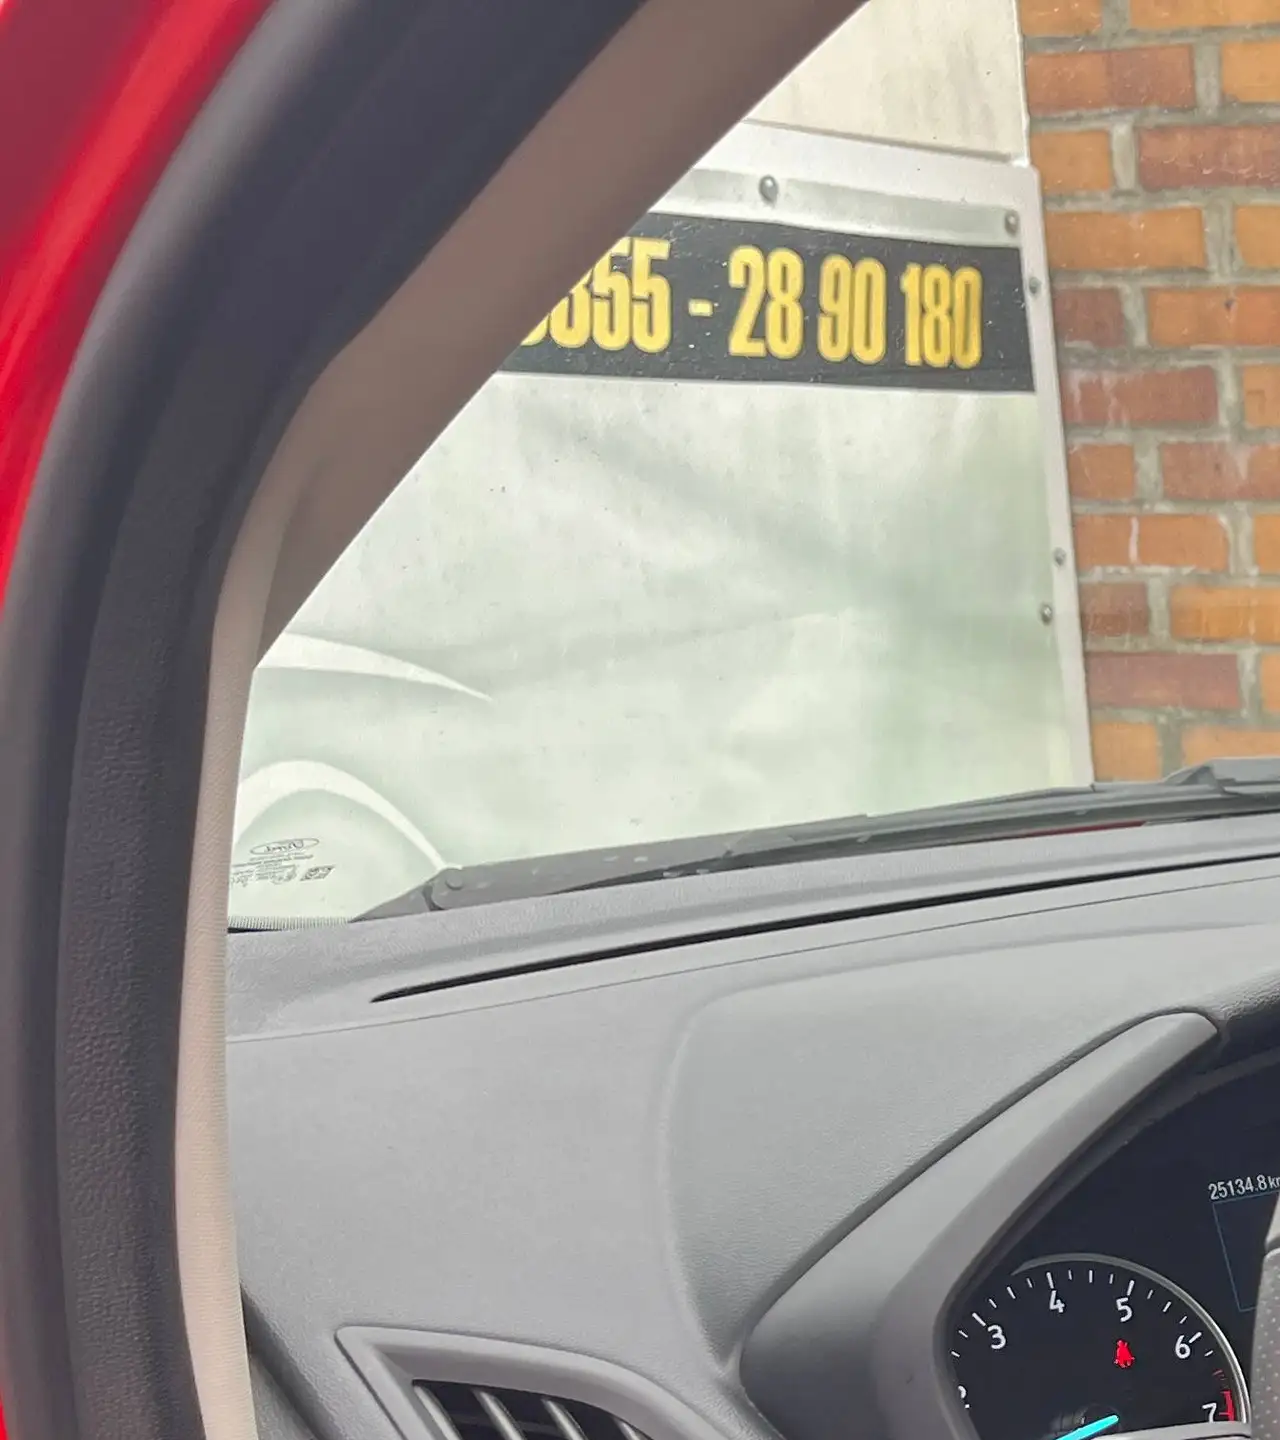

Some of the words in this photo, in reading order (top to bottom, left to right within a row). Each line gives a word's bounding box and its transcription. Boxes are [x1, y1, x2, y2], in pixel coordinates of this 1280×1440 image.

[520, 236, 671, 353] 355
[729, 244, 804, 360] 28
[817, 255, 886, 365] 90
[900, 262, 982, 370] 180
[1049, 1291, 1065, 1314] 4
[1116, 1298, 1133, 1322] 5
[988, 1325, 1006, 1350] 3
[1175, 1336, 1191, 1359] 6
